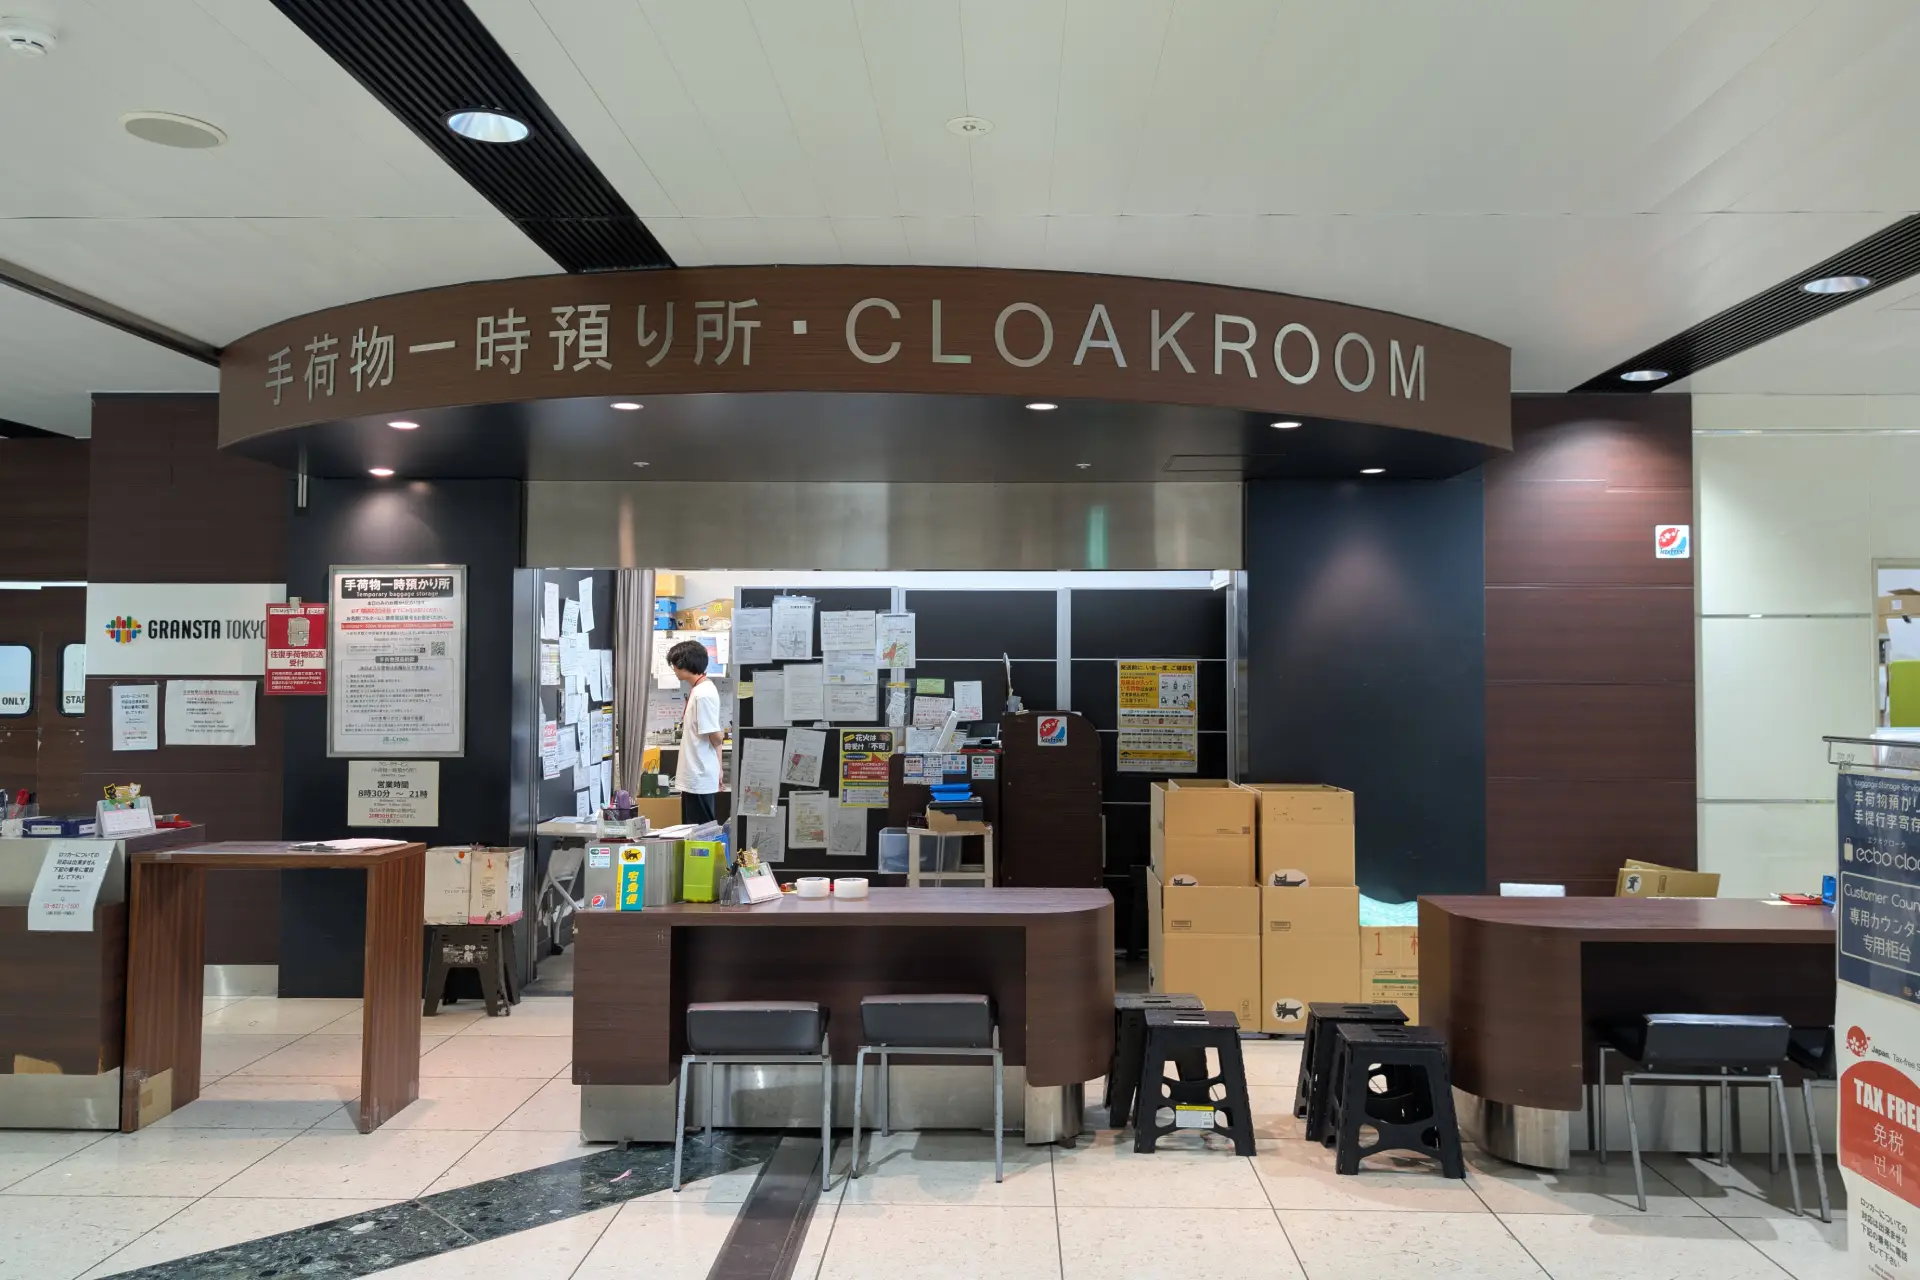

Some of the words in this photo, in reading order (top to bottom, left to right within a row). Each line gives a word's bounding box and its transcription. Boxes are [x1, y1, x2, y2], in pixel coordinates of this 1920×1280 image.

[265, 298, 761, 406] 手荷物一時預り所
[844, 297, 1426, 402] CLOAKROOM
[344, 577, 450, 592] 手荷物一時預かり所
[148, 619, 220, 640] GRANSTA
[270, 650, 324, 658] 往復手荷物配送
[288, 659, 304, 667] 受付
[2, 697, 26, 706] ONLY
[855, 734, 877, 742] 花火は
[358, 789, 390, 798] 8時30分
[409, 790, 428, 798] 21時
[377, 780, 410, 789] 営業時間
[1855, 780, 1878, 789] Luggage
[1878, 781, 1901, 791] Storage
[1856, 846, 1892, 866] ecbo
[1844, 883, 1889, 905] Customer
[1862, 933, 1912, 963] 专用柜台
[1893, 1053, 1916, 1069] Tax-free
[1853, 1077, 1885, 1116] TAX
[1872, 1122, 1904, 1157] 免税
[1873, 1154, 1903, 1187] 면세
[1860, 1197, 1908, 1235] ロッカーについての
[1861, 1210, 1907, 1248] 対応は出来ません
[1860, 1222, 1909, 1263] 下記の番号に電話
[1868, 1241, 1901, 1268] をして下さい
